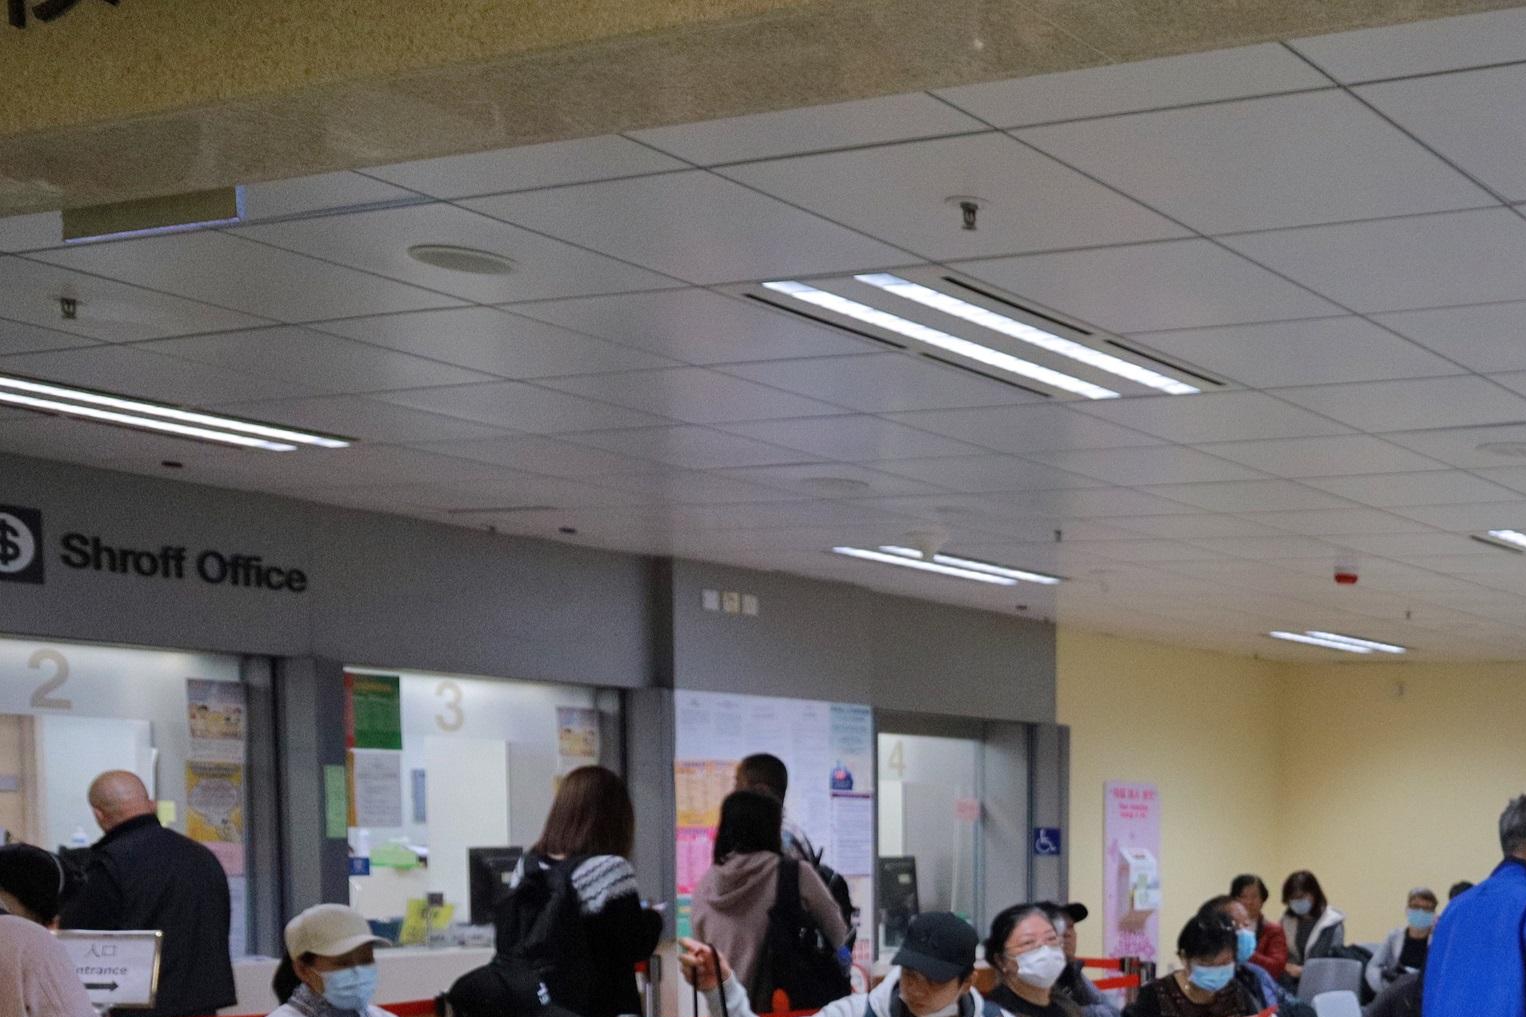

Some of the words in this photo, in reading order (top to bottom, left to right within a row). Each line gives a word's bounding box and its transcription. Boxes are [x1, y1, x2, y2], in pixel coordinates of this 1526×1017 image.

[60, 532, 186, 579] Shroff
[197, 550, 308, 593] Office
[27, 648, 72, 711] 2
[435, 680, 466, 733] 3
[76, 966, 128, 975] ntrance
[84, 943, 117, 957] 入口
